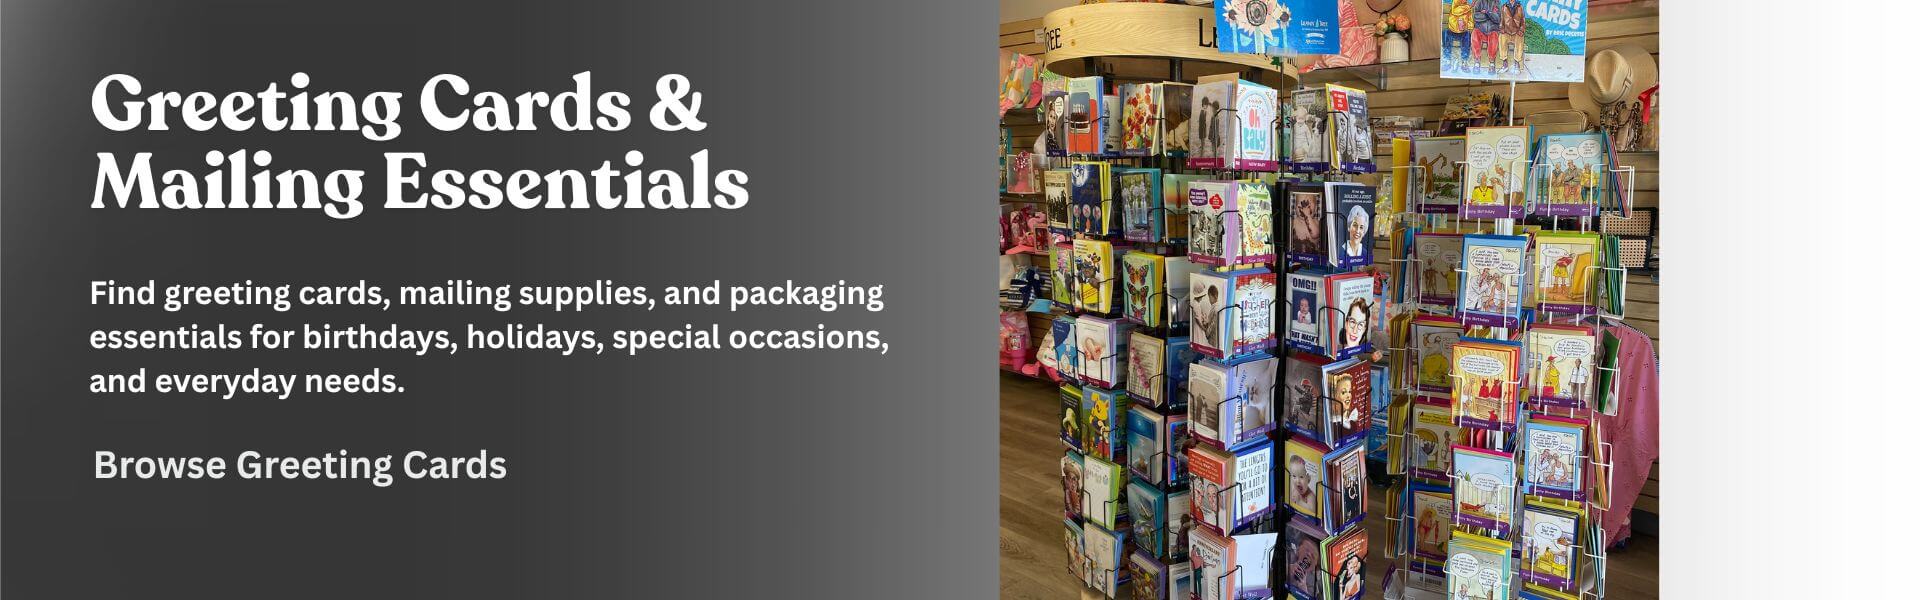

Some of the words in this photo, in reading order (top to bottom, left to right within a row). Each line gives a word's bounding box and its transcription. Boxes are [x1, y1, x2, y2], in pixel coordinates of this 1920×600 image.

[1526, 0, 1581, 30] CARDS
[1248, 108, 1260, 128] Oh
[1292, 278, 1317, 291] OMG!!
